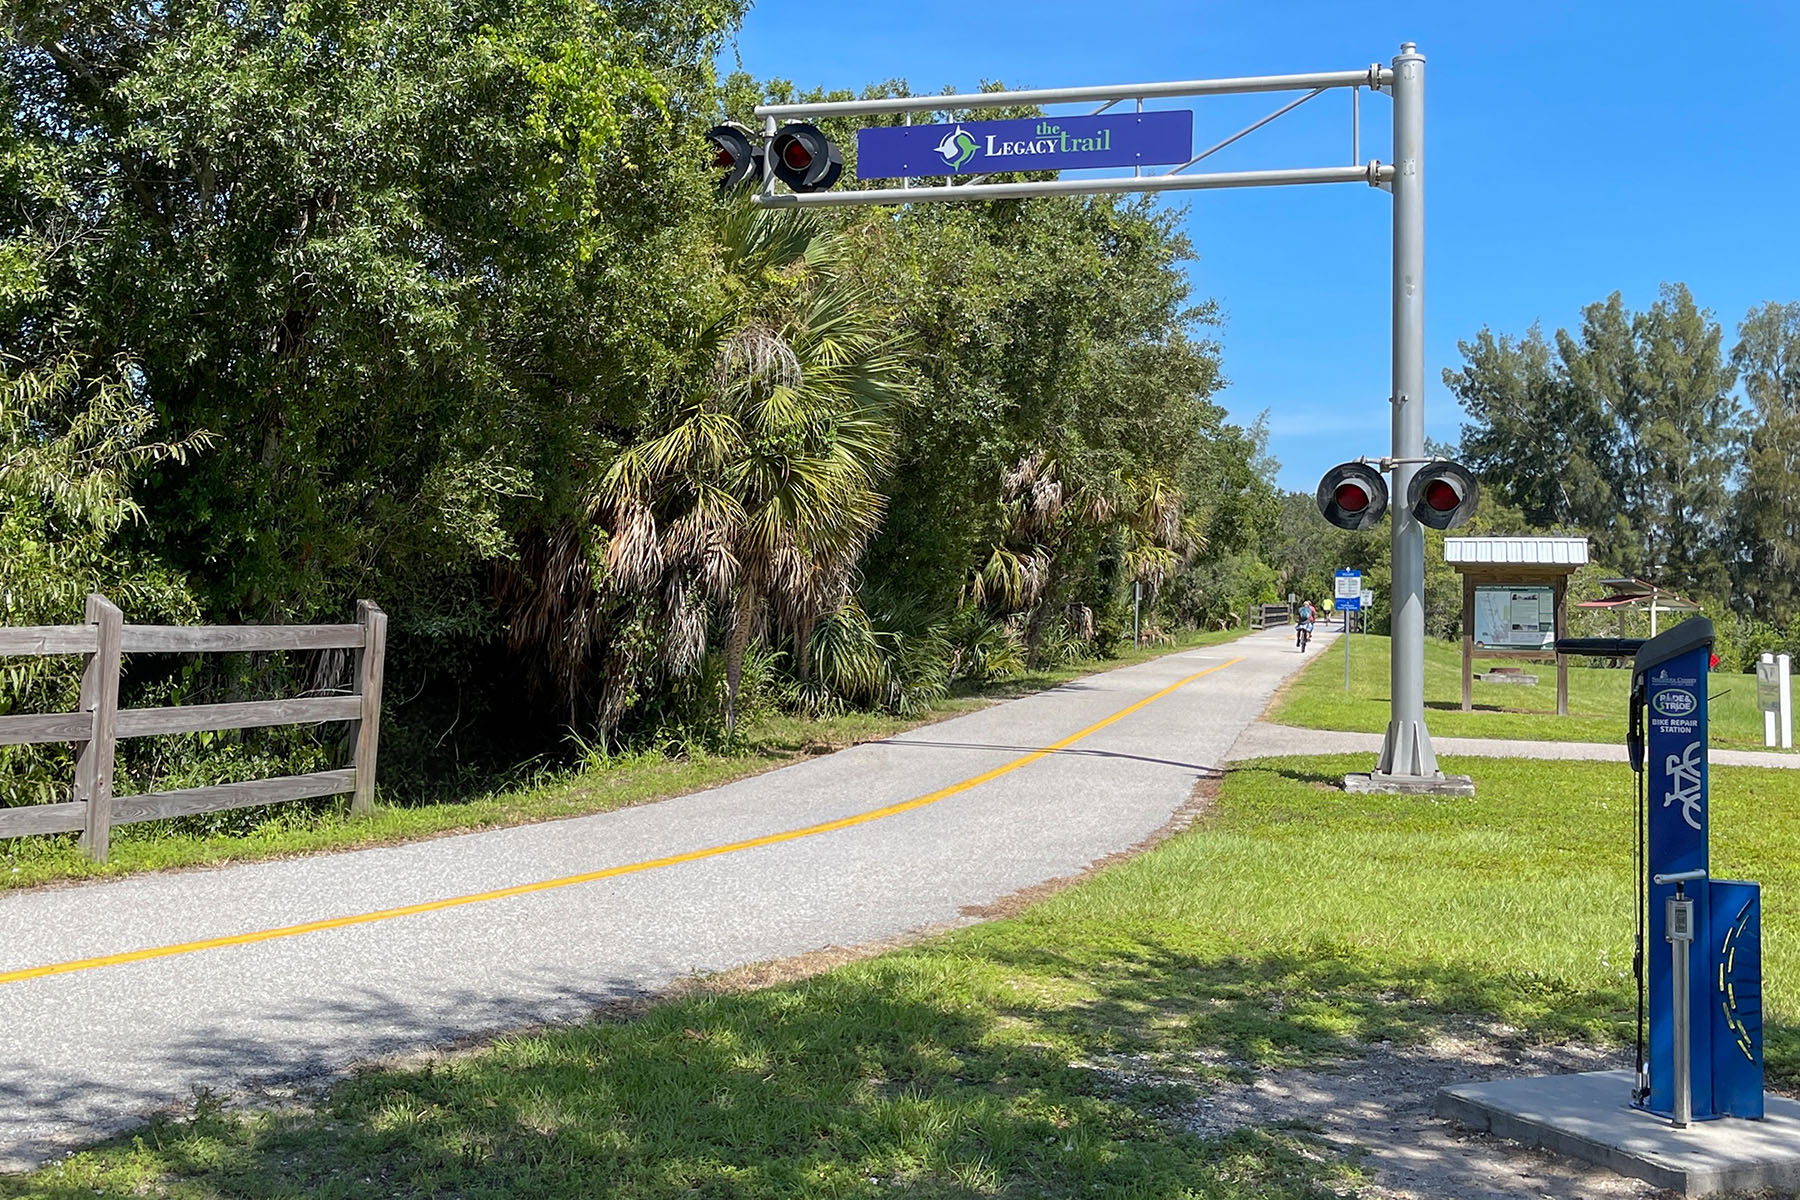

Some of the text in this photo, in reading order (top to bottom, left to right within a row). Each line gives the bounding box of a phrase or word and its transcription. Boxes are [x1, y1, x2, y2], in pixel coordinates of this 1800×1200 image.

[1036, 122, 1060, 135] the
[984, 129, 1111, 157] LEGACY trail
[1660, 702, 1691, 712] STRIDE
[1670, 719, 1698, 727] REPAIR
